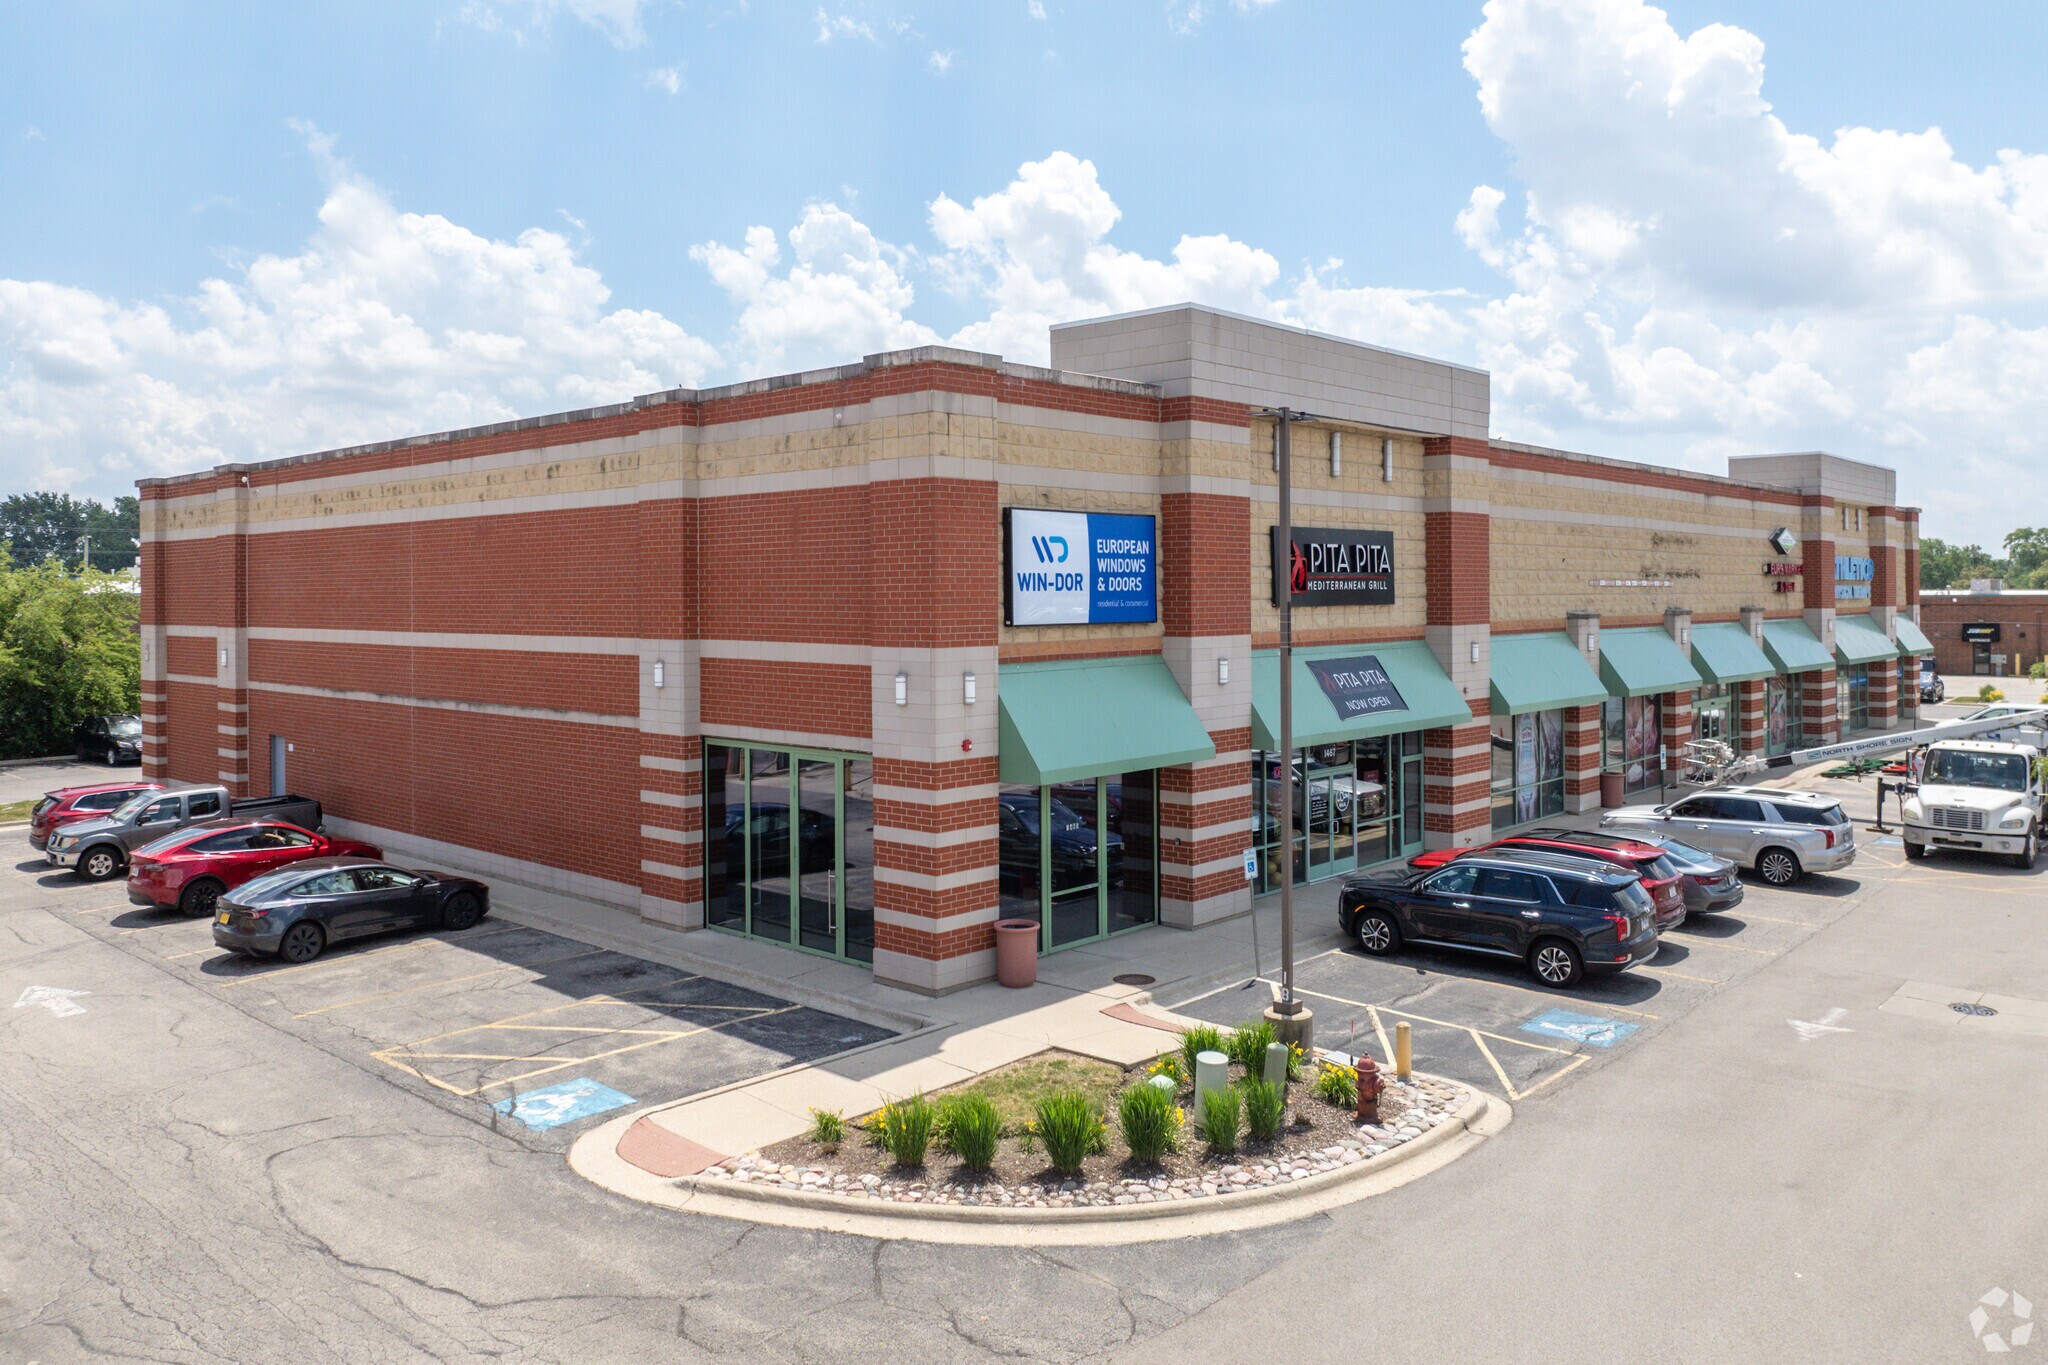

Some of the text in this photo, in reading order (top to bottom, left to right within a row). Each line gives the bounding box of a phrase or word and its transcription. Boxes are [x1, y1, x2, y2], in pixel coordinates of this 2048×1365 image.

[1096, 539, 1149, 554] EUROPEAN
[1097, 558, 1146, 573] WINDOWS
[1311, 543, 1391, 573] PITA PITA
[1835, 556, 1874, 581] THLETICO
[1017, 572, 1084, 592] WIN-DOR
[1097, 577, 1142, 592] & DOORS
[1308, 580, 1387, 591] MEDITERRANEAN GRILL
[1333, 670, 1388, 689] PITA PITA
[1345, 696, 1391, 710] NOW OPEN
[1822, 736, 1913, 756] NORTH SHORE SIGN
